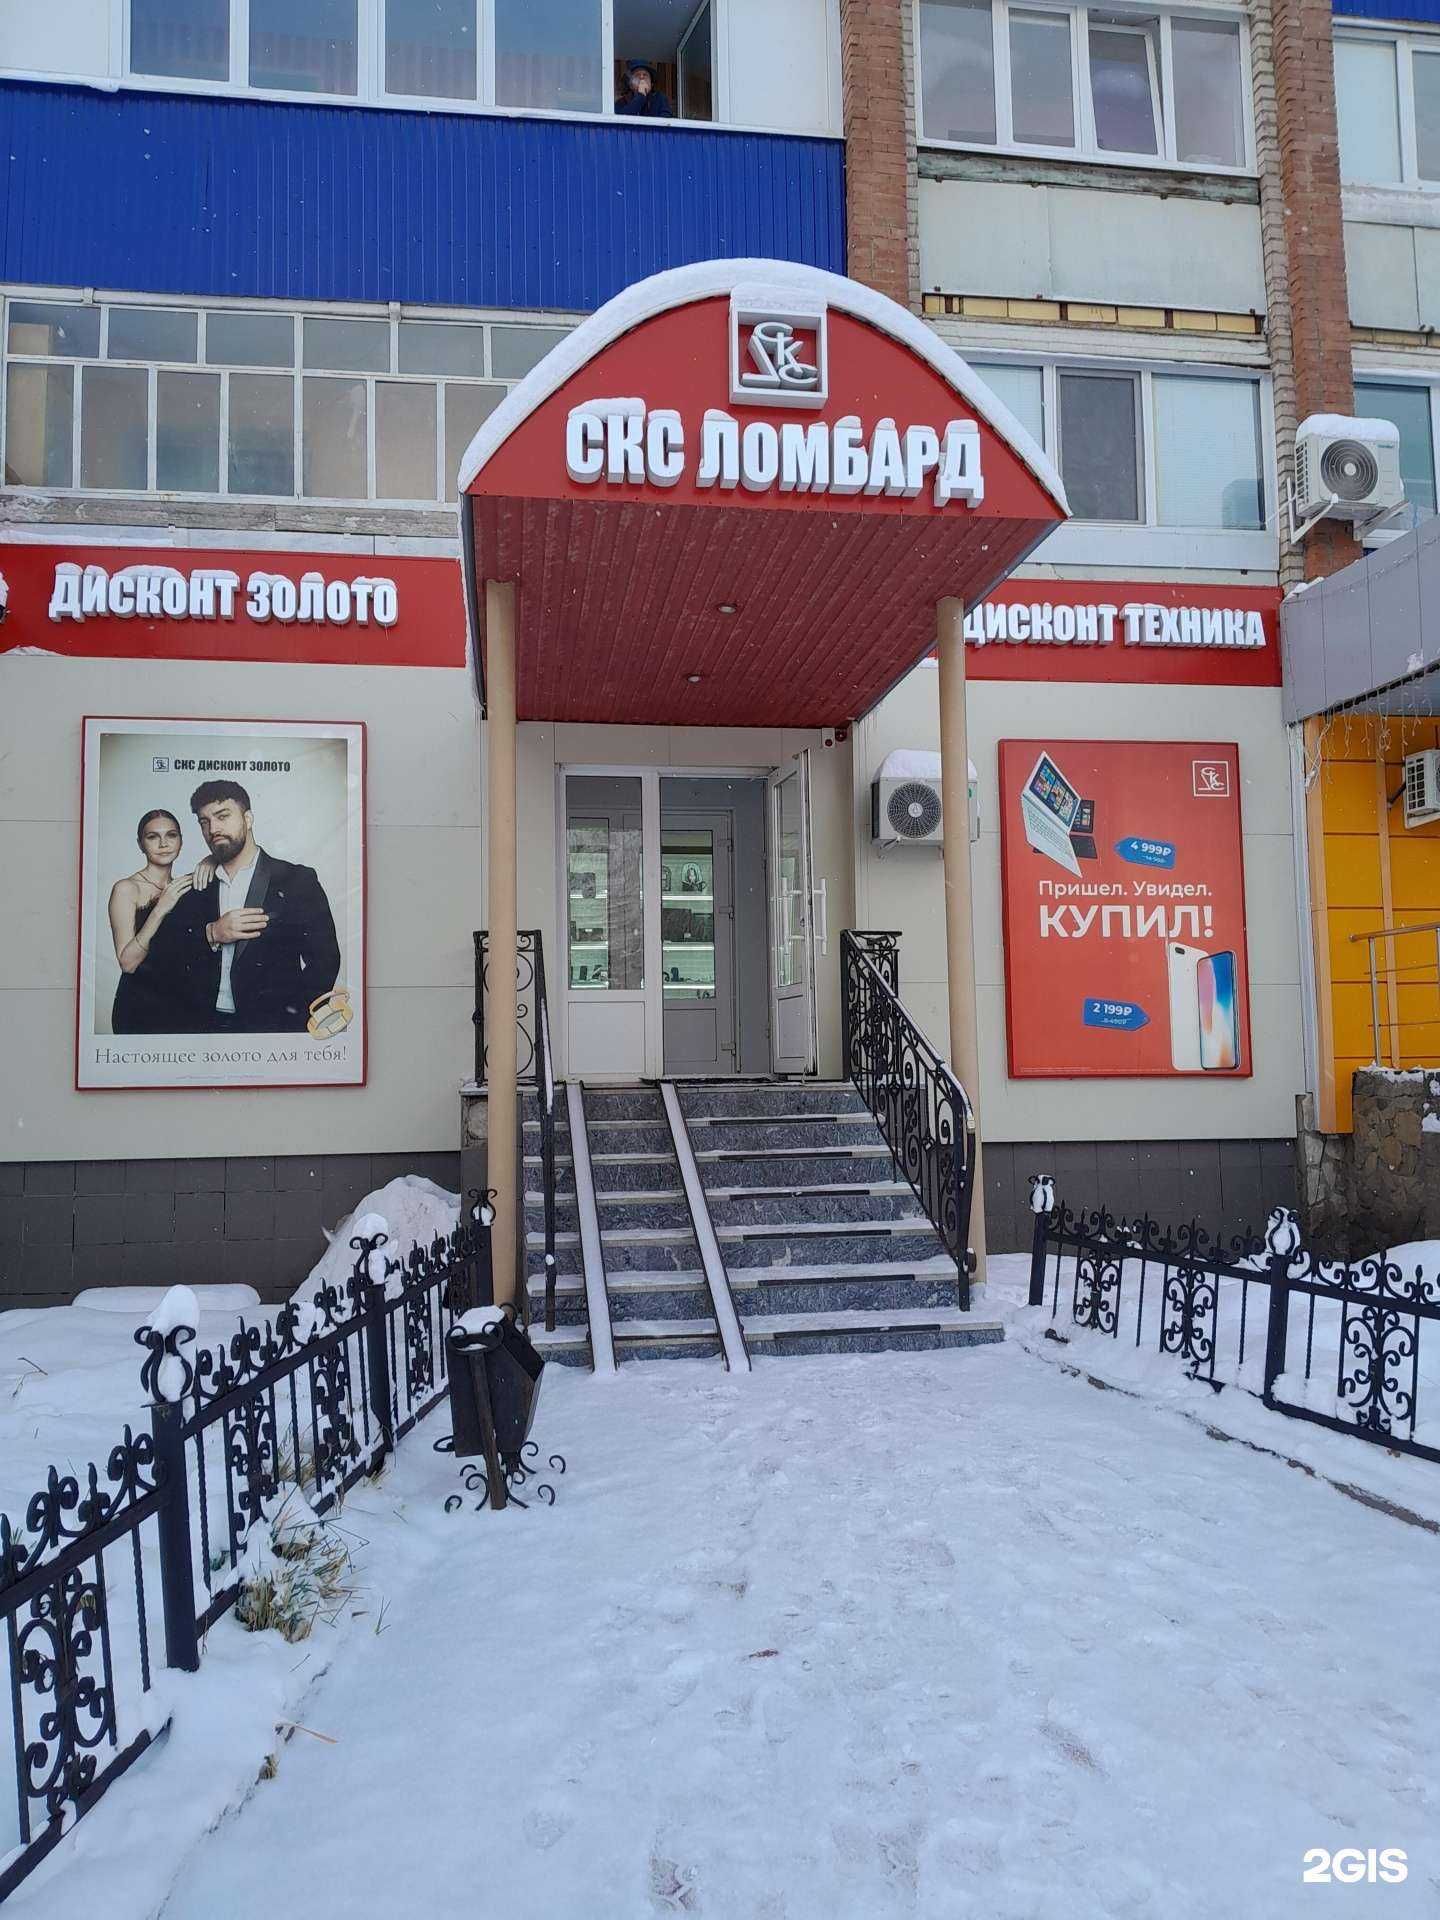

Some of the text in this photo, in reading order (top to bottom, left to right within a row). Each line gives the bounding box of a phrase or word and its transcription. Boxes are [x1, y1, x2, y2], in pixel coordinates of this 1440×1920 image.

[566, 411, 985, 508] СКС ЛОМБАРД
[49, 571, 398, 627] ДИСКОНТ ЗОЛОТО
[964, 602, 1267, 649] ДИСКОНТ ТЕХНИКА
[174, 759, 195, 771] СКС
[197, 759, 247, 772] ДИСКОНТ
[249, 761, 291, 772] ЗОЛОТО
[1039, 880, 1213, 899] Пришел. Увидел.
[1039, 904, 1214, 938] КУПИЛ!
[95, 1045, 347, 1065] Настоящее золото для тебя!
